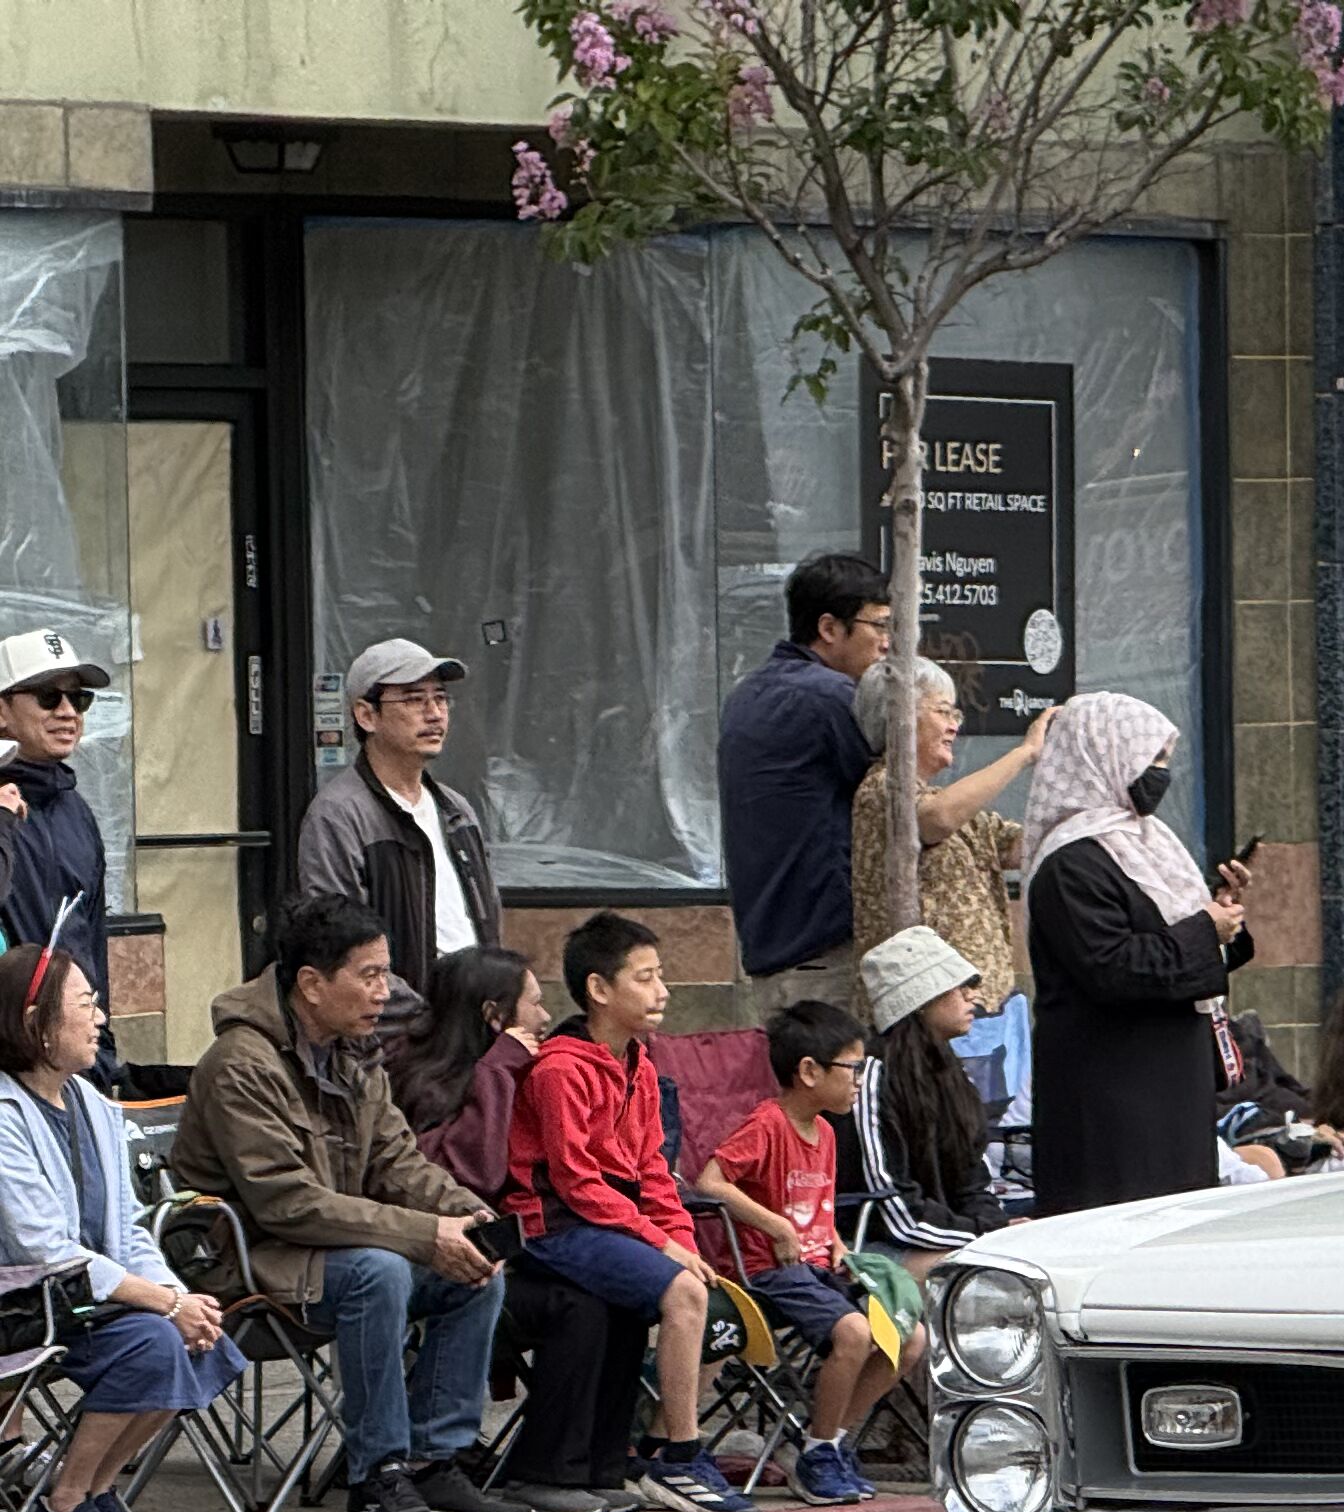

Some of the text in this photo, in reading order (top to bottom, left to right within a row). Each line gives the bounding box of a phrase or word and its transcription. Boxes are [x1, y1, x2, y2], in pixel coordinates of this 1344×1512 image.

[934, 441, 1003, 473] LEASE
[964, 493, 1006, 511] RETAIL
[1006, 495, 1047, 512] SPACE
[945, 552, 995, 577] Nguyen
